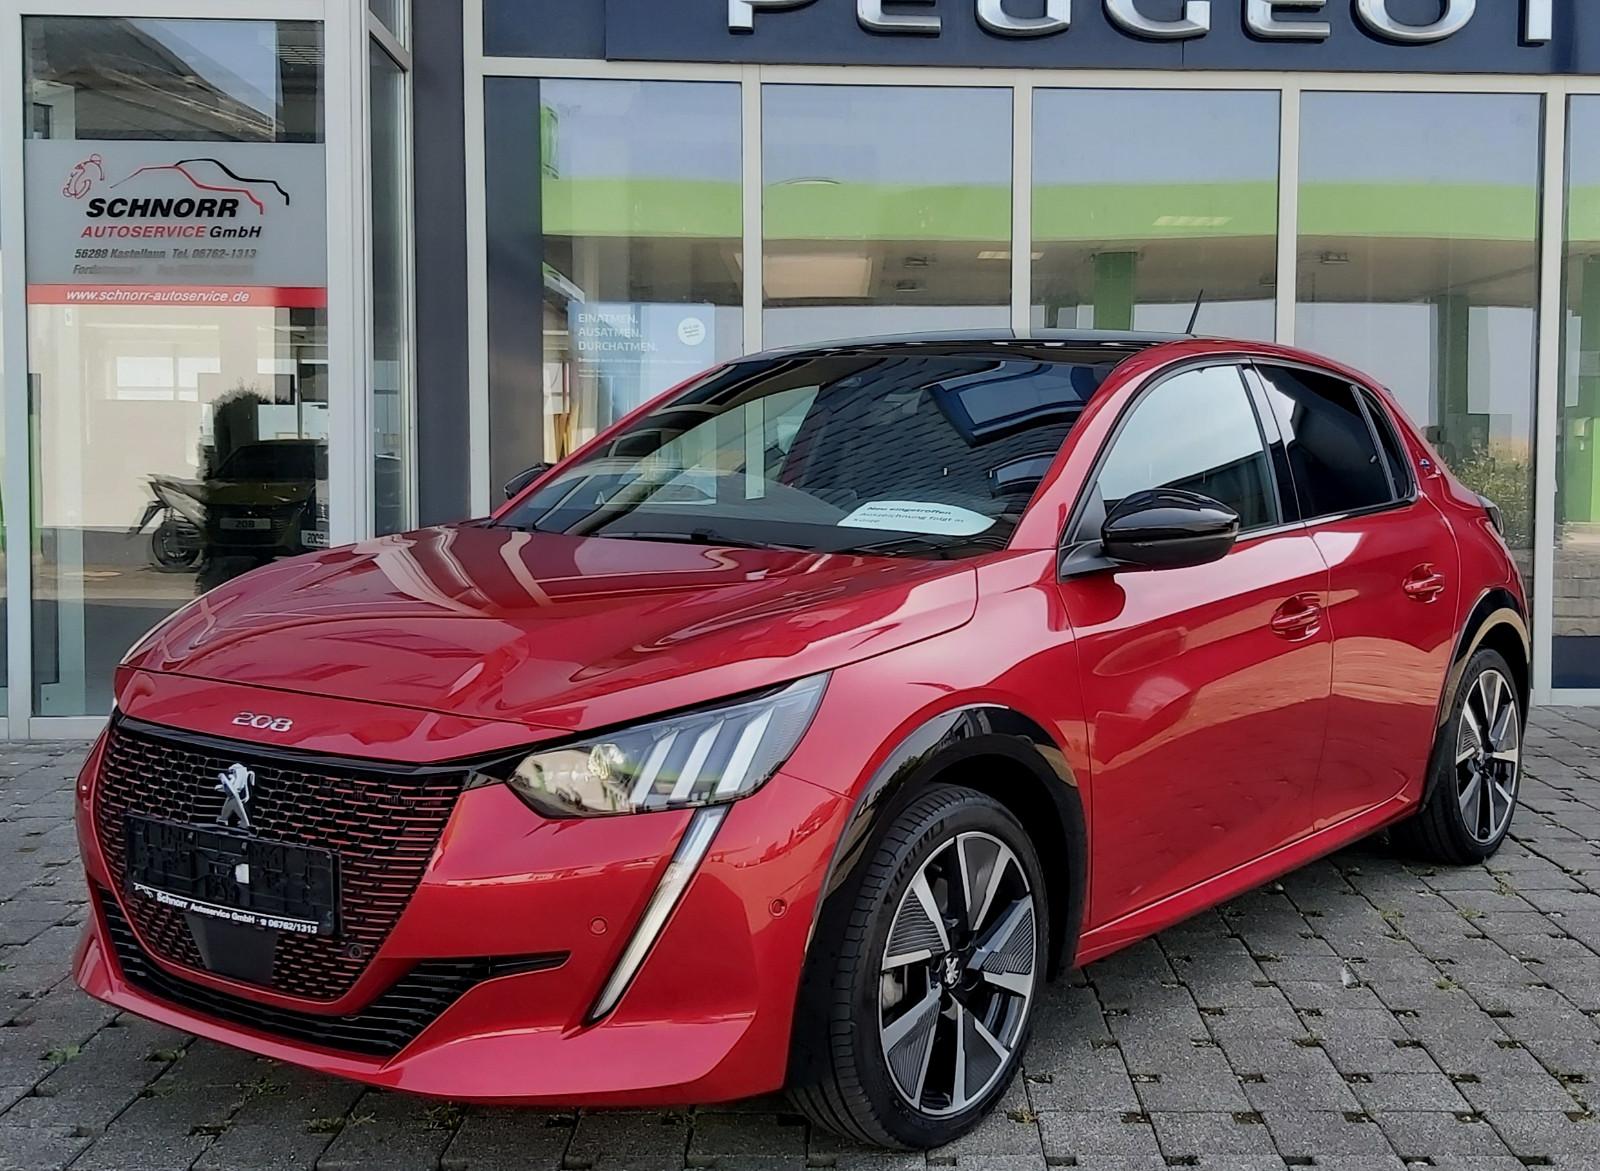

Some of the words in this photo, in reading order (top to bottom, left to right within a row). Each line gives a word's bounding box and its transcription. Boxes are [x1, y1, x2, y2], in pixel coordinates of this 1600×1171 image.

[86, 198, 239, 218] SCHNORR
[81, 226, 206, 238] AUTOSERVICE
[209, 226, 262, 238] GmbH
[74, 249, 108, 259] 56288
[66, 290, 249, 303] www.schnorr-autoservice.de
[578, 313, 639, 324] EINATMEN.
[578, 327, 643, 338] AUSATMEN.
[578, 341, 659, 352] DURCHATMEN.
[231, 711, 294, 732] 208
[156, 892, 187, 909] Schnorr
[190, 904, 230, 919] Autoservice
[231, 912, 255, 924] GmbH
